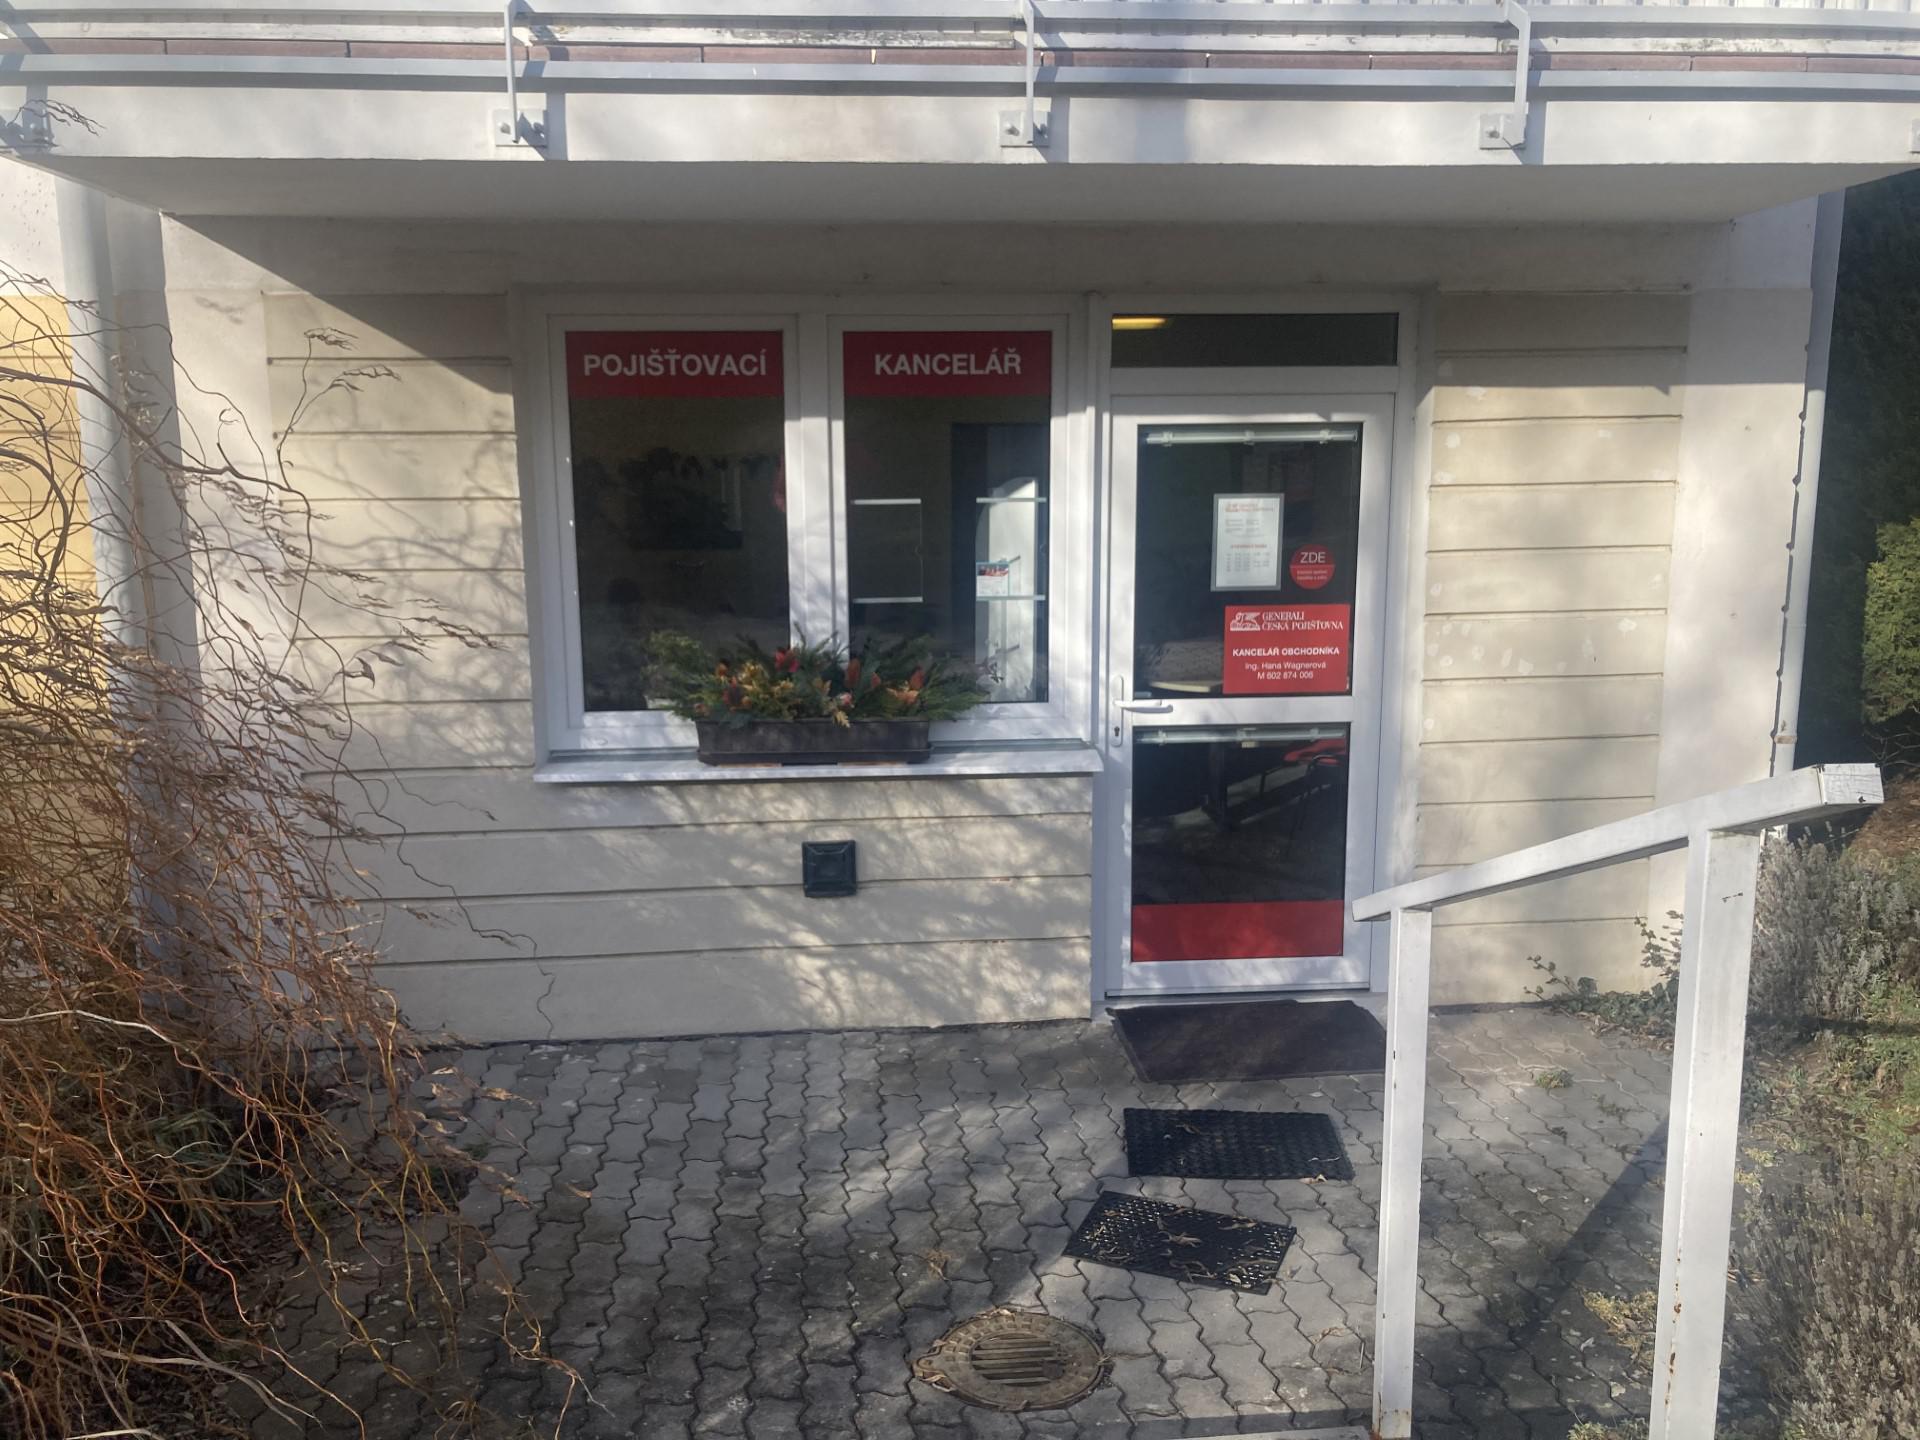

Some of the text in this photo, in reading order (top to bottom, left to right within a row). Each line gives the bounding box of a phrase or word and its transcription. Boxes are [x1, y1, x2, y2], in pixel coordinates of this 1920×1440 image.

[583, 348, 768, 376] POJIŠŤOVACÍ
[874, 347, 1022, 375] KANCELÁŘ
[1300, 551, 1326, 564] ZDE
[1262, 611, 1305, 621] GENERALI
[1261, 619, 1344, 631] ČESKÁ POJIŠŤOVNA
[1232, 646, 1340, 657] KANCELÁŘ OBCHODNÍKA
[1245, 661, 1327, 672] Ing. Hana Wagnerová
[1257, 672, 1265, 680] M
